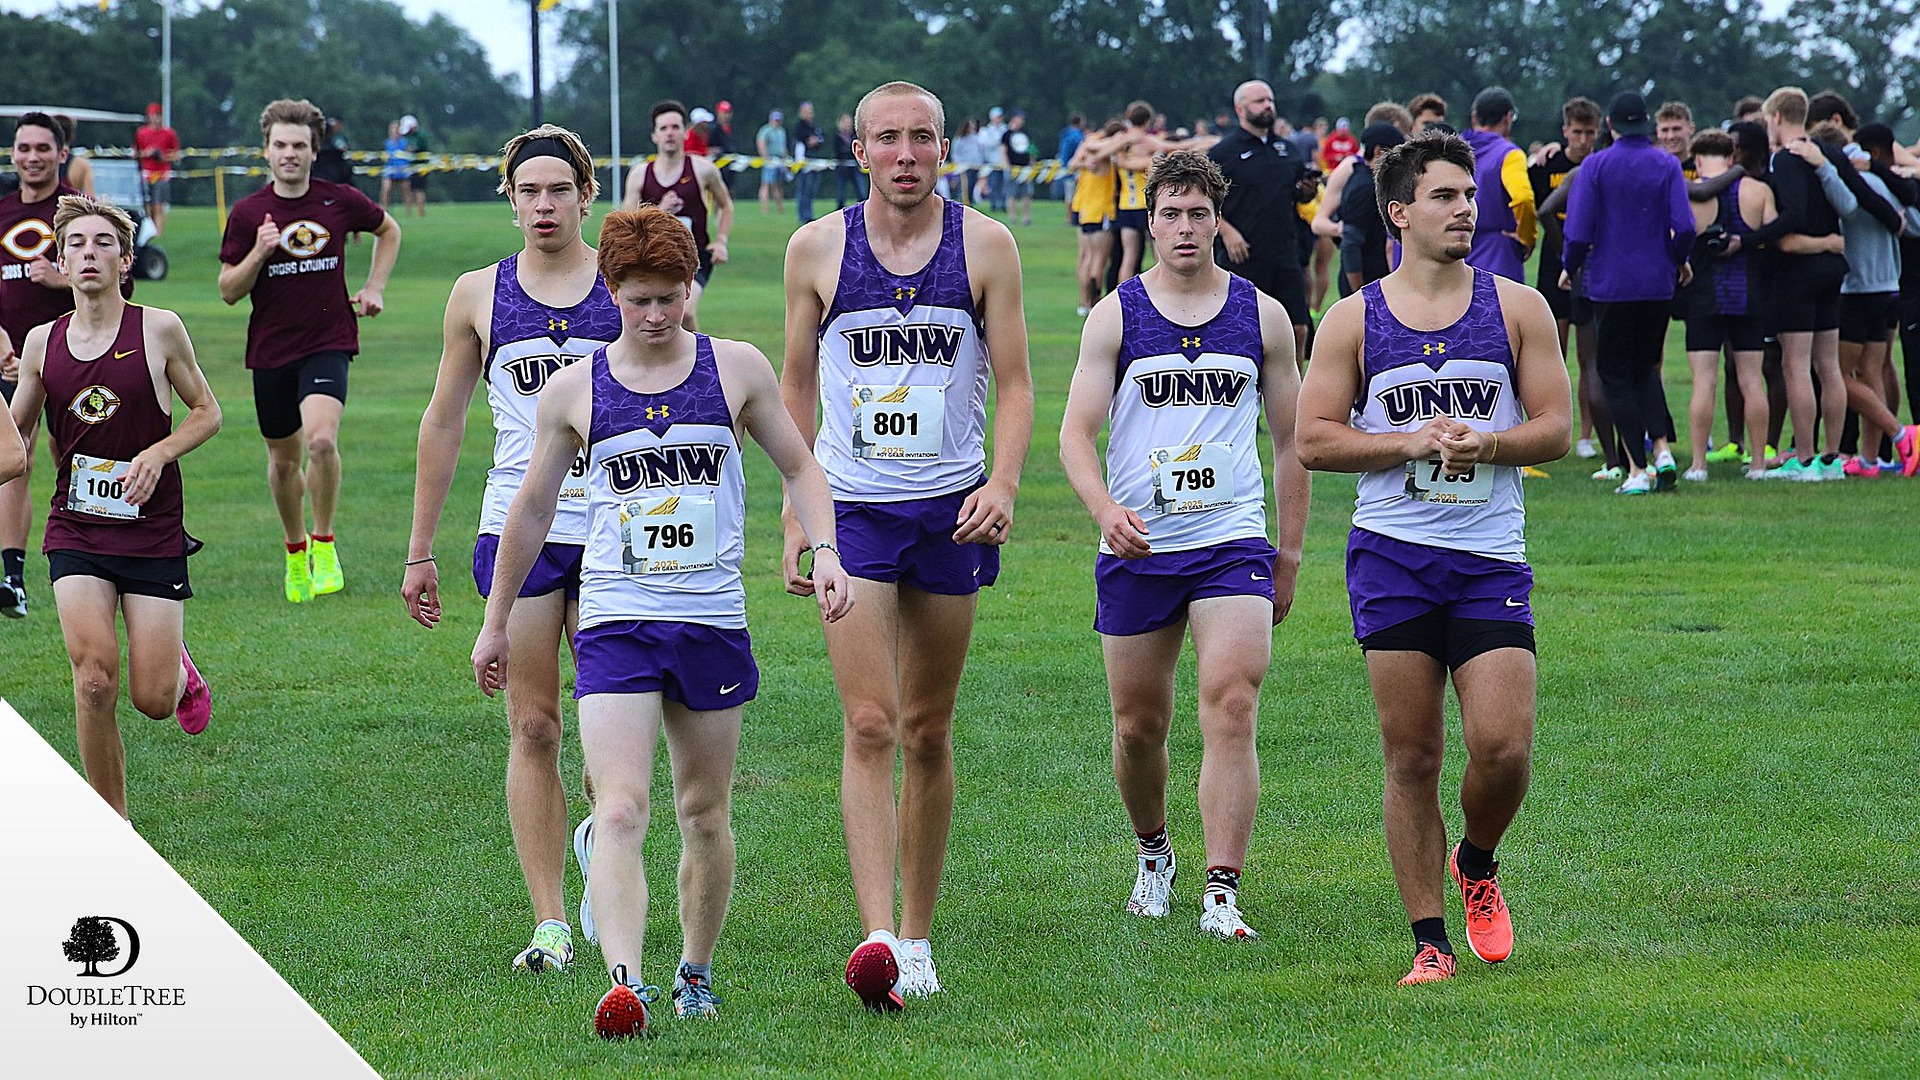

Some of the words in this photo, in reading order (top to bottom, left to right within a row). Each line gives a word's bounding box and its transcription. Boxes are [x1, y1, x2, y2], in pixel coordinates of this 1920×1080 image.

[268, 261, 298, 278] CROSS
[299, 256, 339, 273] COUNTRY
[838, 323, 966, 368] UNW
[1132, 368, 1252, 408] UNW
[1375, 378, 1503, 426] UNW
[873, 412, 918, 436] 801
[881, 446, 905, 456] 2025
[599, 443, 730, 495] UNW
[1172, 467, 1216, 492] 798
[87, 477, 123, 500] 100
[643, 523, 694, 549] 796
[654, 559, 679, 569] 2025
